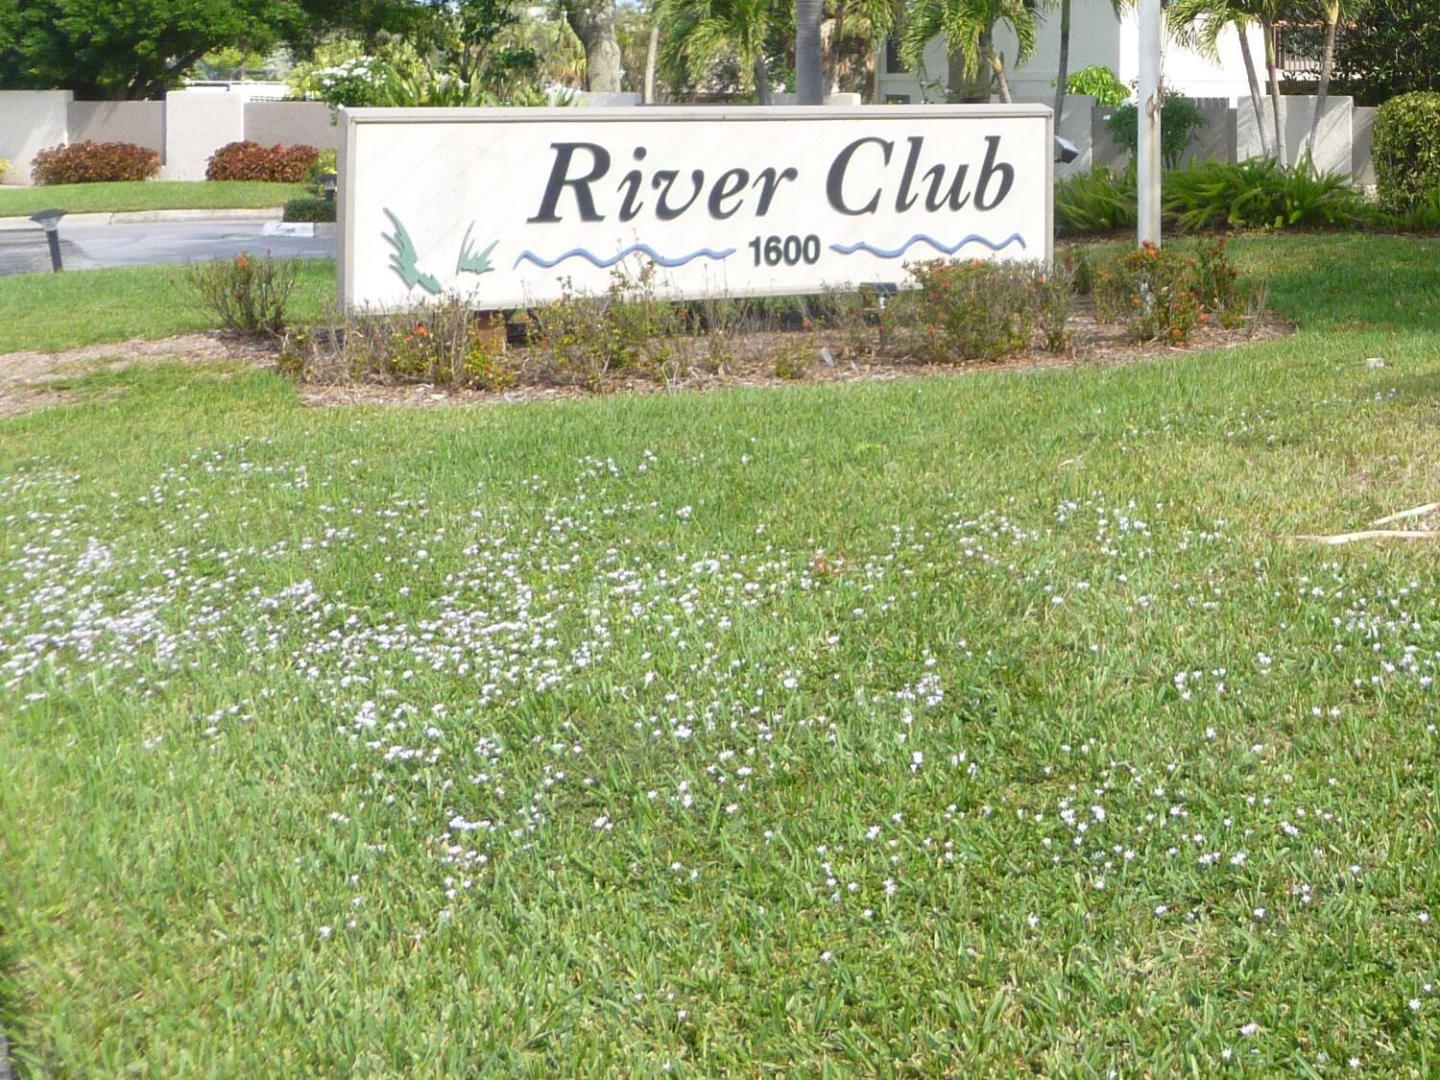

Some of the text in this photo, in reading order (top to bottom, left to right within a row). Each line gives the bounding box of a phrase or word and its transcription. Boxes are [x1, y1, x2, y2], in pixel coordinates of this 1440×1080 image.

[527, 136, 1016, 225] River Club
[748, 234, 821, 267] 1600
